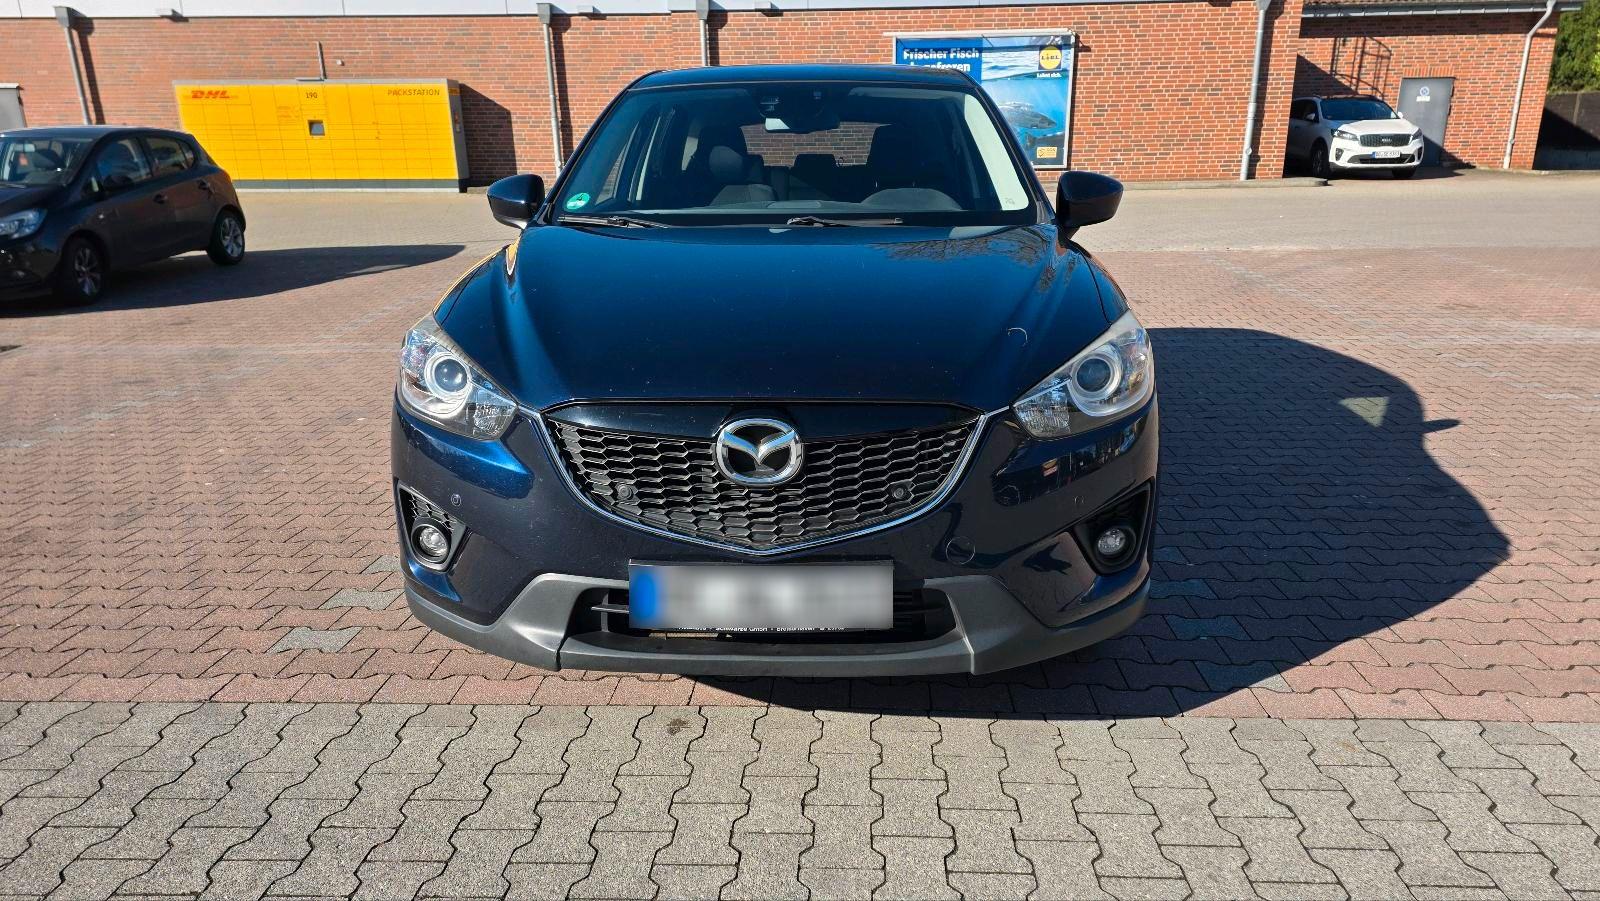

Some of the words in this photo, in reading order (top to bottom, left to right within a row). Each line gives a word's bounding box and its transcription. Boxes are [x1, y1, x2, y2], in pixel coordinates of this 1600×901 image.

[903, 48, 949, 60] Frischer
[949, 47, 980, 59] Fisch
[191, 90, 230, 99] DHL
[305, 91, 318, 99] 190
[387, 88, 440, 96] PACKSTATION
